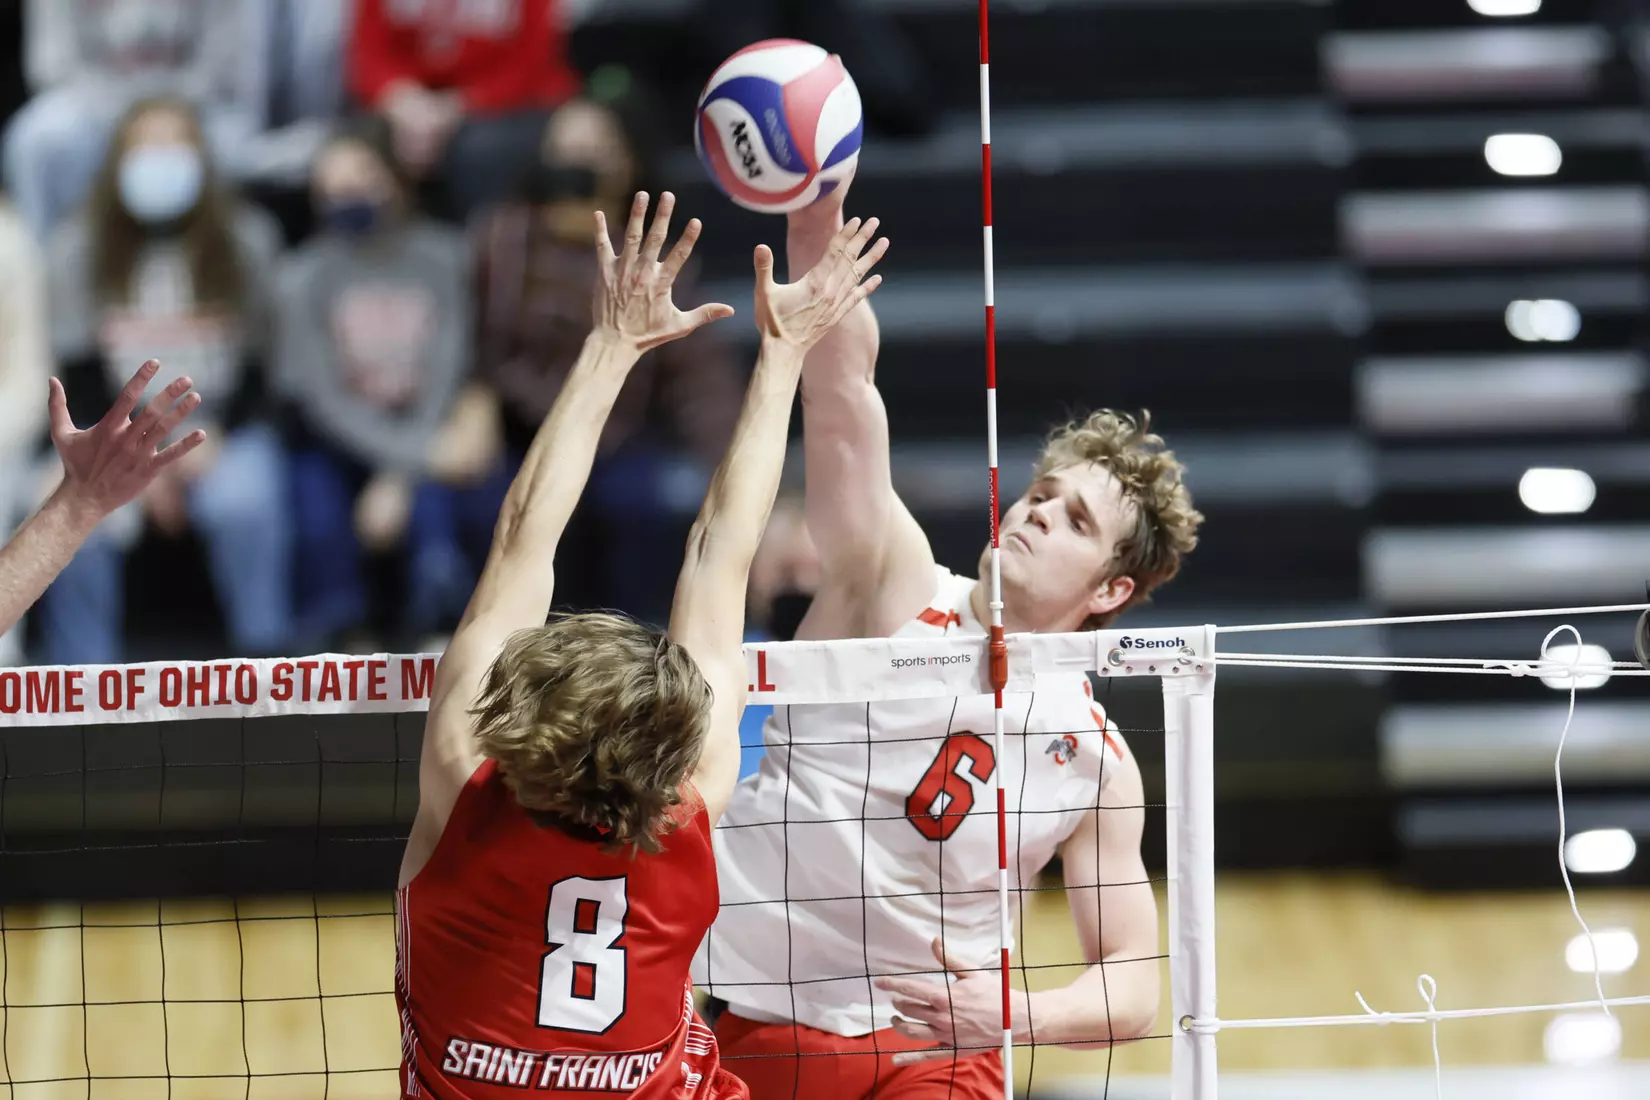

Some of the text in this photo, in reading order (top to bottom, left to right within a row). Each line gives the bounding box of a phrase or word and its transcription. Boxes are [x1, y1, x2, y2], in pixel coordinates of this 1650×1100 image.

[890, 653, 971, 669] sports imports
[1134, 636, 1186, 649] Senoh
[98, 669, 146, 710] OF
[159, 664, 258, 707] OHIO
[270, 660, 388, 702] STATE
[904, 730, 996, 841] 6
[535, 874, 629, 1036] 8
[441, 1036, 543, 1088] SAINT
